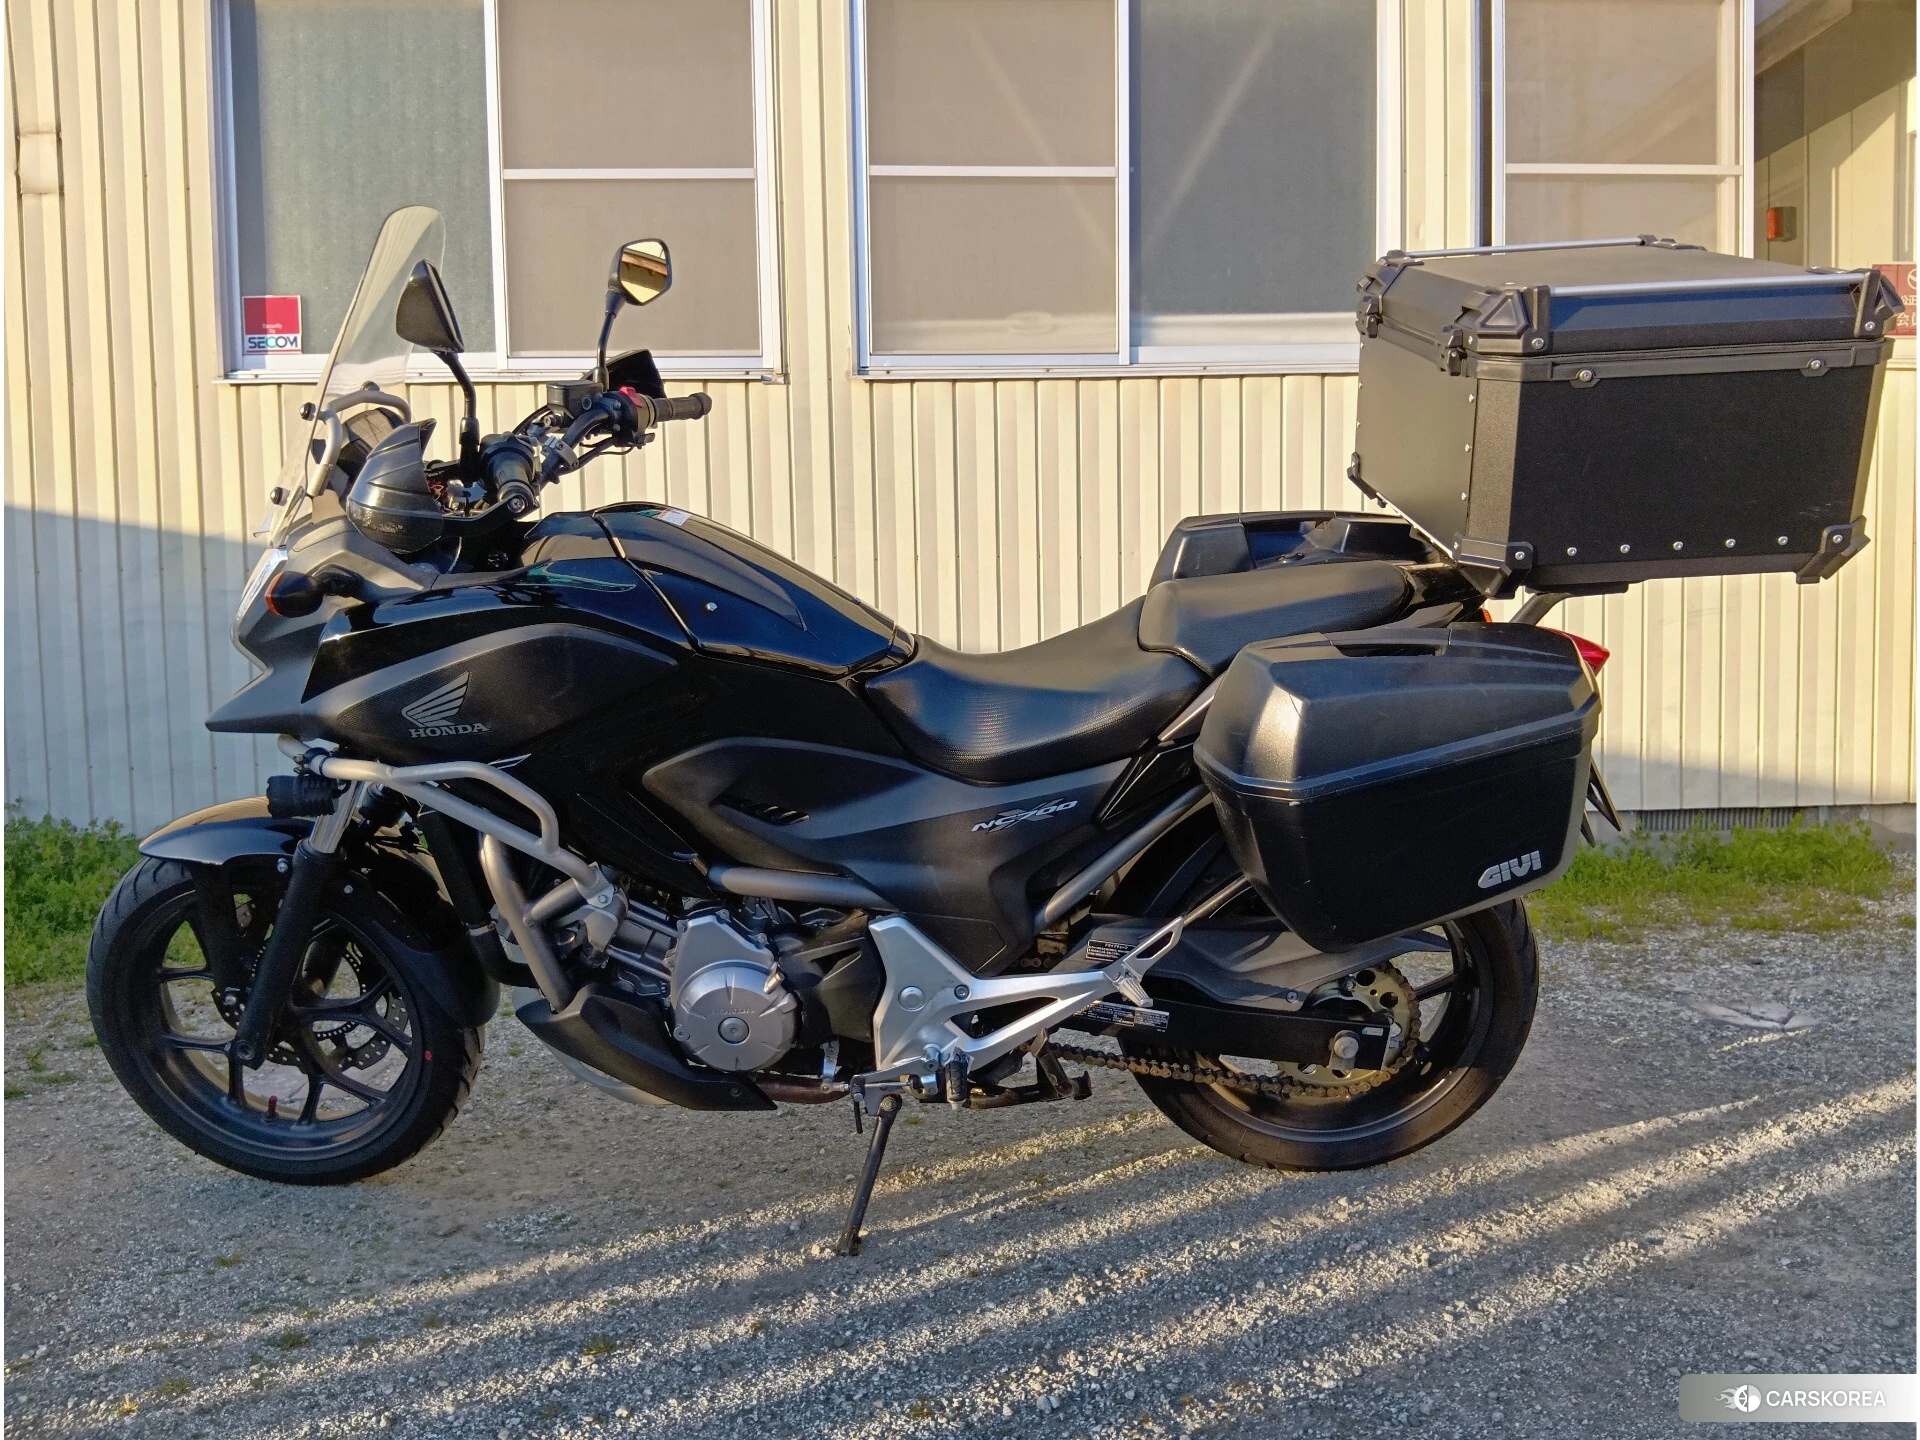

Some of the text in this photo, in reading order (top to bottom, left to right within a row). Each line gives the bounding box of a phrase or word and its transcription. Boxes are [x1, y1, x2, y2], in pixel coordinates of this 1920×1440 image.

[262, 323, 282, 331] Security
[248, 336, 298, 349] SECOM
[408, 722, 490, 738] HONDA
[1478, 850, 1542, 889] GIVI
